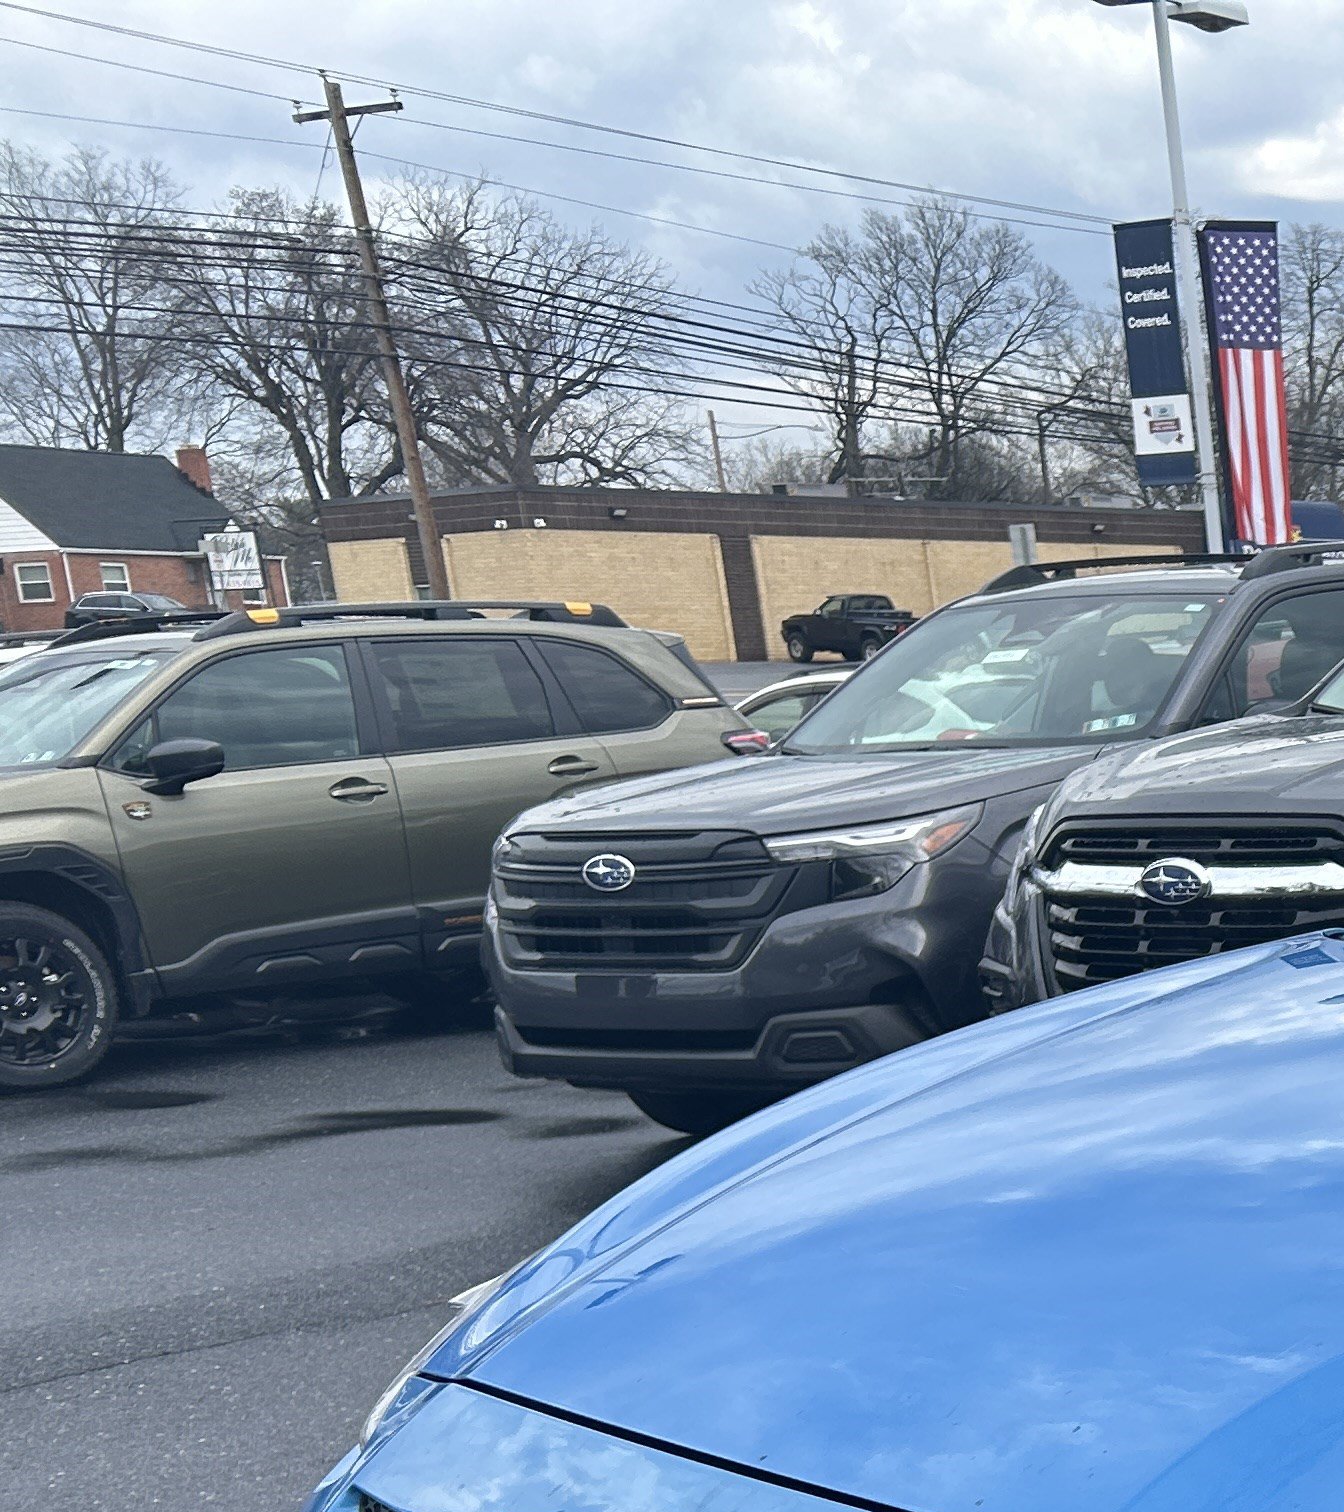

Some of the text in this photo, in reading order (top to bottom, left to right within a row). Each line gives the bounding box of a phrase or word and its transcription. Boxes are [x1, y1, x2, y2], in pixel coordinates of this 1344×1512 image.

[1122, 261, 1173, 279] Inspected.
[1125, 287, 1171, 303] Certified.
[1128, 312, 1172, 329] Covered.
